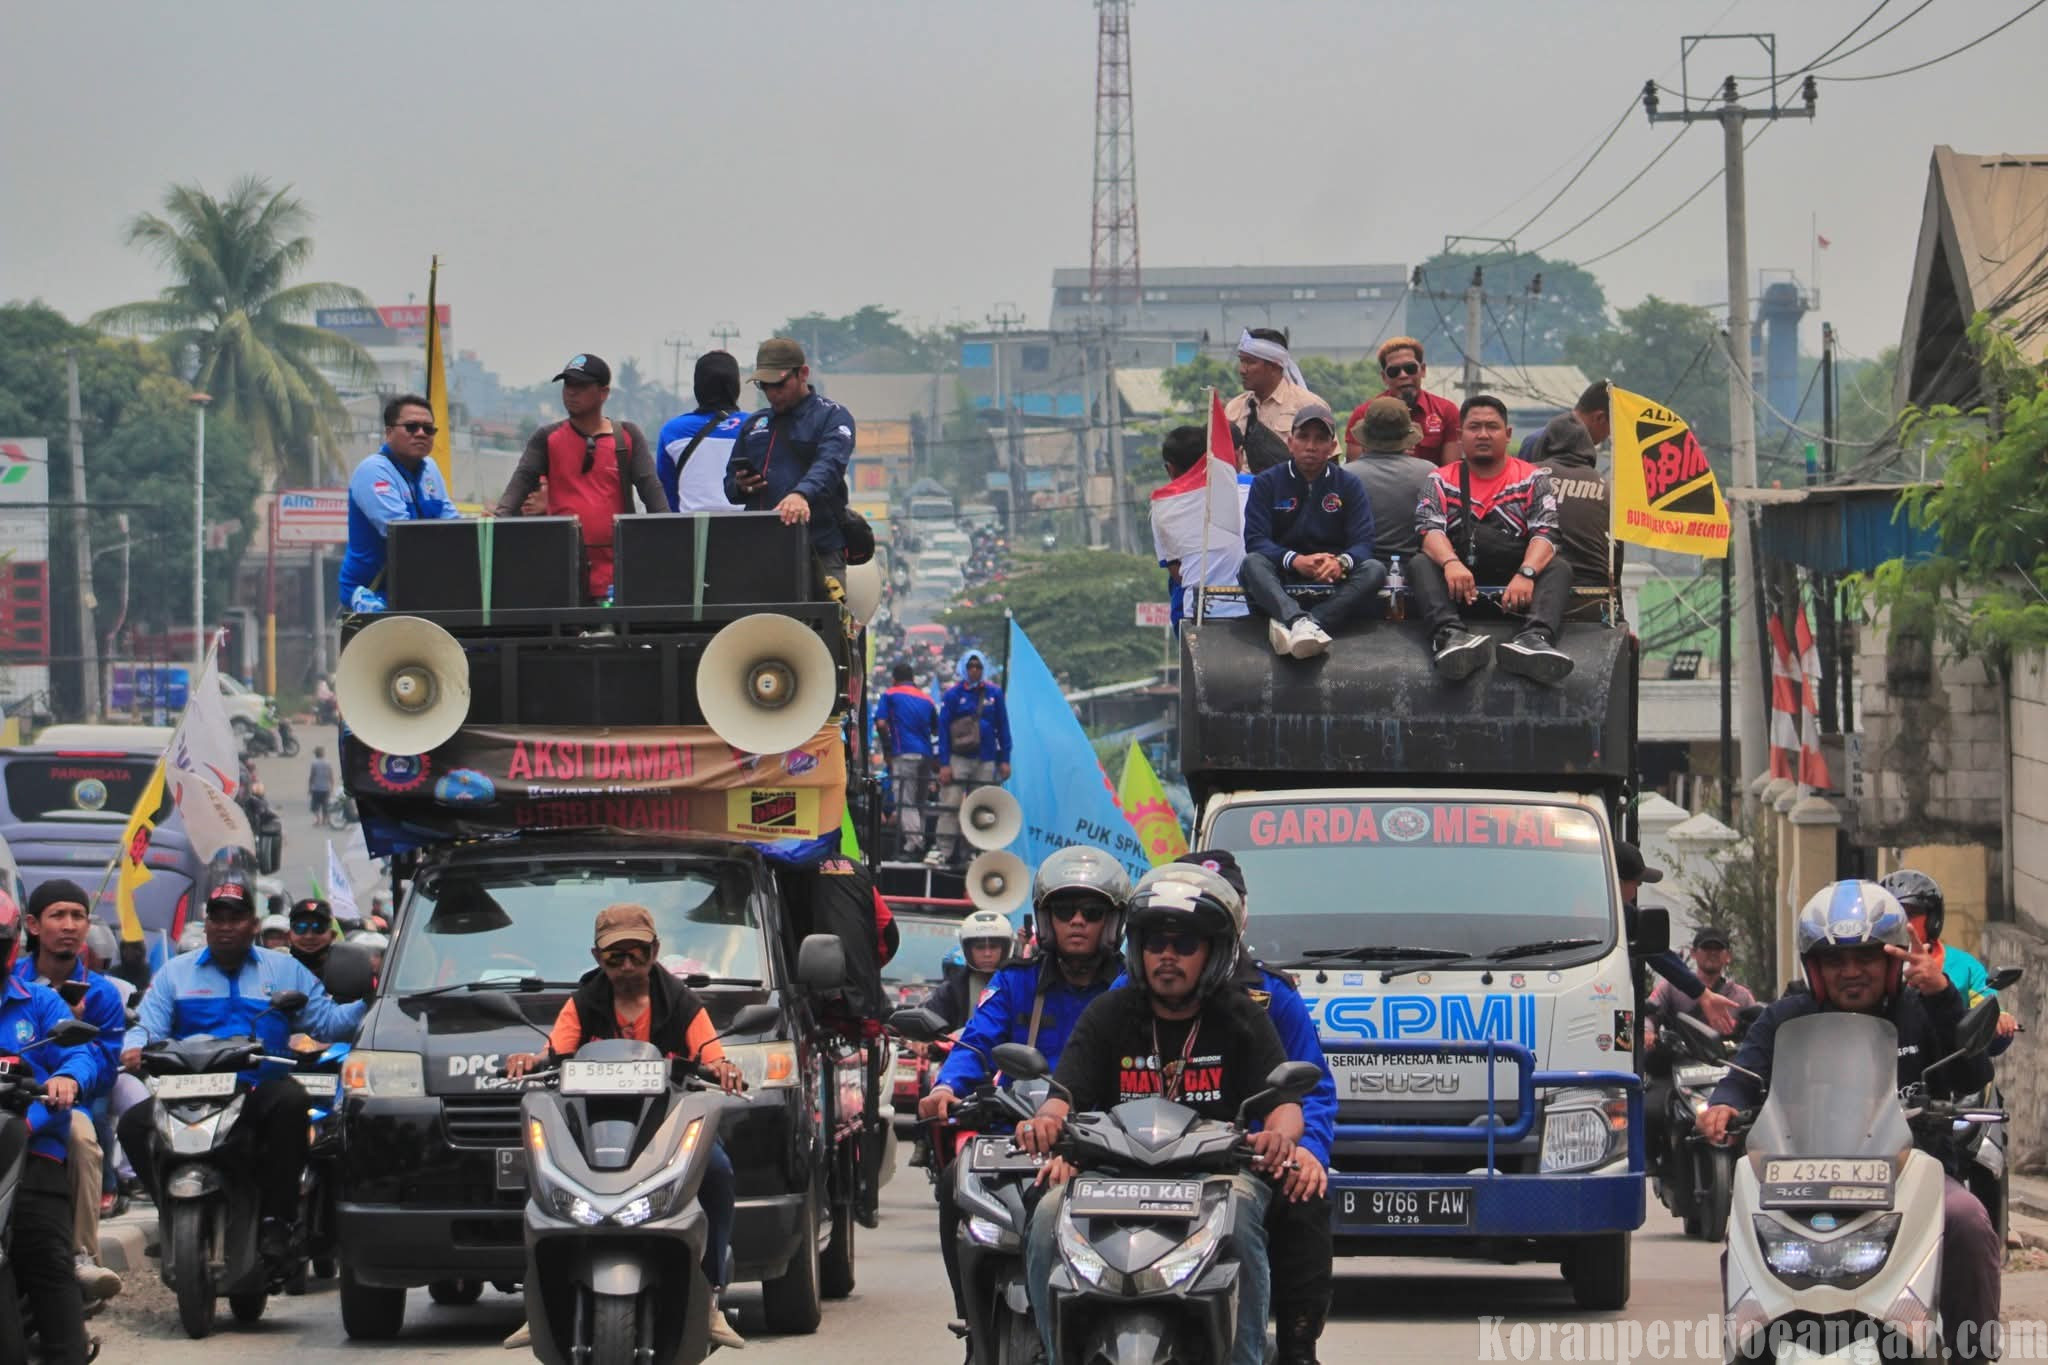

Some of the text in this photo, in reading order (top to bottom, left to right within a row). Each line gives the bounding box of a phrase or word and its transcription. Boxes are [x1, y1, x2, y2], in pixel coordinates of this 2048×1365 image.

[1549, 476, 1605, 504] spmi
[507, 740, 693, 781] AKSI DAMAI
[1075, 818, 1112, 846] PUK
[1250, 806, 1564, 848] GARDA METAL
[448, 1054, 500, 1076] DPC
[1332, 1053, 1379, 1067] SERIKAT
[1383, 1052, 1436, 1066] PEKERJA
[1436, 1050, 1474, 1066] METAL
[568, 1065, 577, 1077] B
[633, 1063, 662, 1076] KIL
[1184, 1067, 1223, 1092] DAY
[1350, 1071, 1460, 1094] ISUZU
[1185, 1089, 1222, 1102] 2025
[501, 1151, 513, 1165] D
[1769, 1164, 1889, 1182] B 4346 KJB
[1080, 1183, 1092, 1197] B
[1158, 1186, 1196, 1199] KAE
[1343, 1191, 1465, 1214] B 9766 FAW
